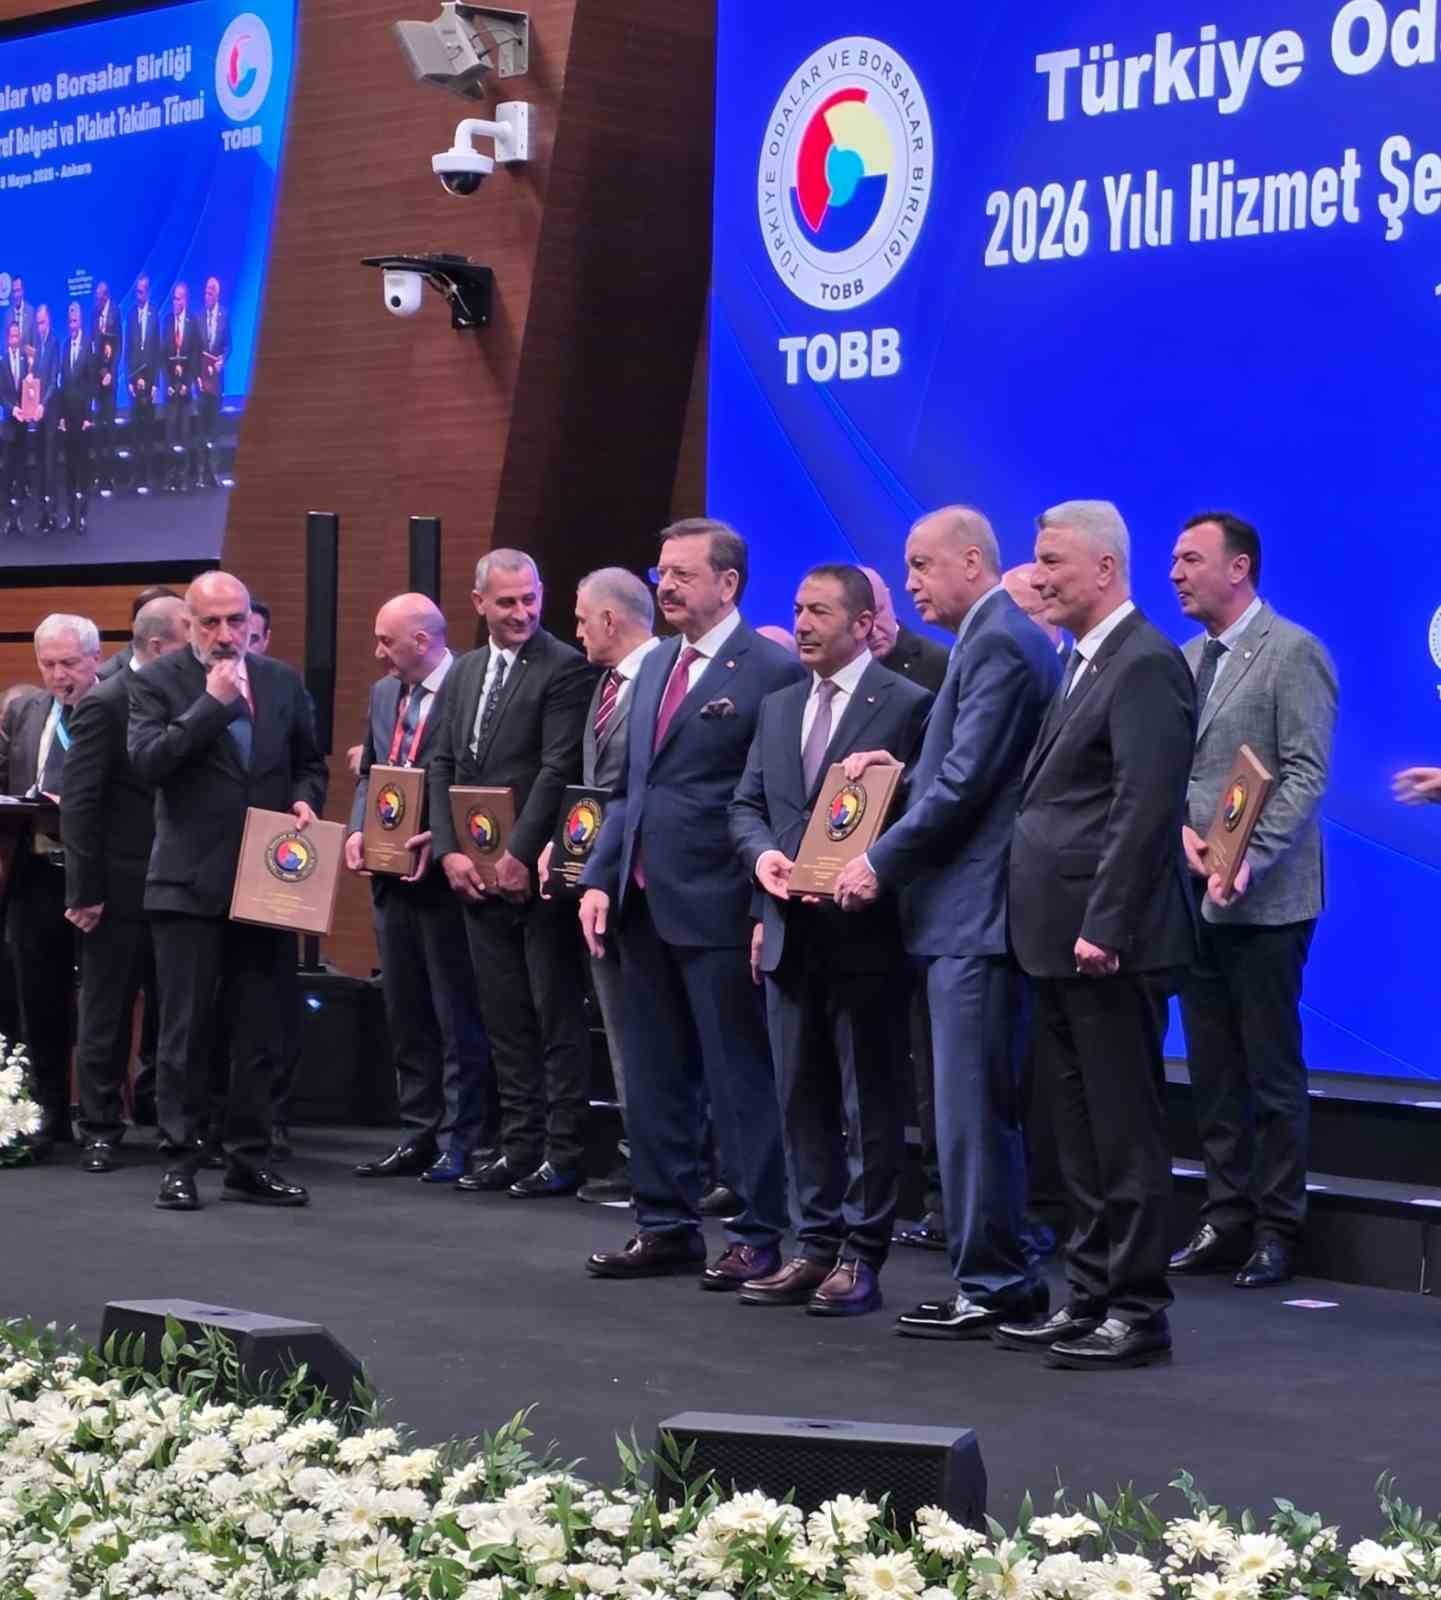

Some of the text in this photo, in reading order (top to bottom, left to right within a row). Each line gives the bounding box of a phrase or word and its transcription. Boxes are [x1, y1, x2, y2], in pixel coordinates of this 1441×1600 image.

[32, 83, 52, 104] ve
[57, 63, 132, 99] Borsalar
[136, 45, 192, 82] Birliği
[1035, 24, 1304, 121] Türkiye
[77, 111, 116, 143] Plaket
[117, 101, 161, 135] Takdim
[163, 90, 204, 125] Töreni
[769, 65, 822, 156] ODALAR
[828, 50, 850, 70] VE
[858, 50, 924, 152] BORSALAR
[222, 126, 262, 151] TOBB
[984, 179, 1089, 267] 2026
[1103, 169, 1173, 252] Yılı
[1189, 148, 1361, 242] Hizmet
[820, 278, 865, 301] TOBB
[778, 327, 901, 385] TOBB
